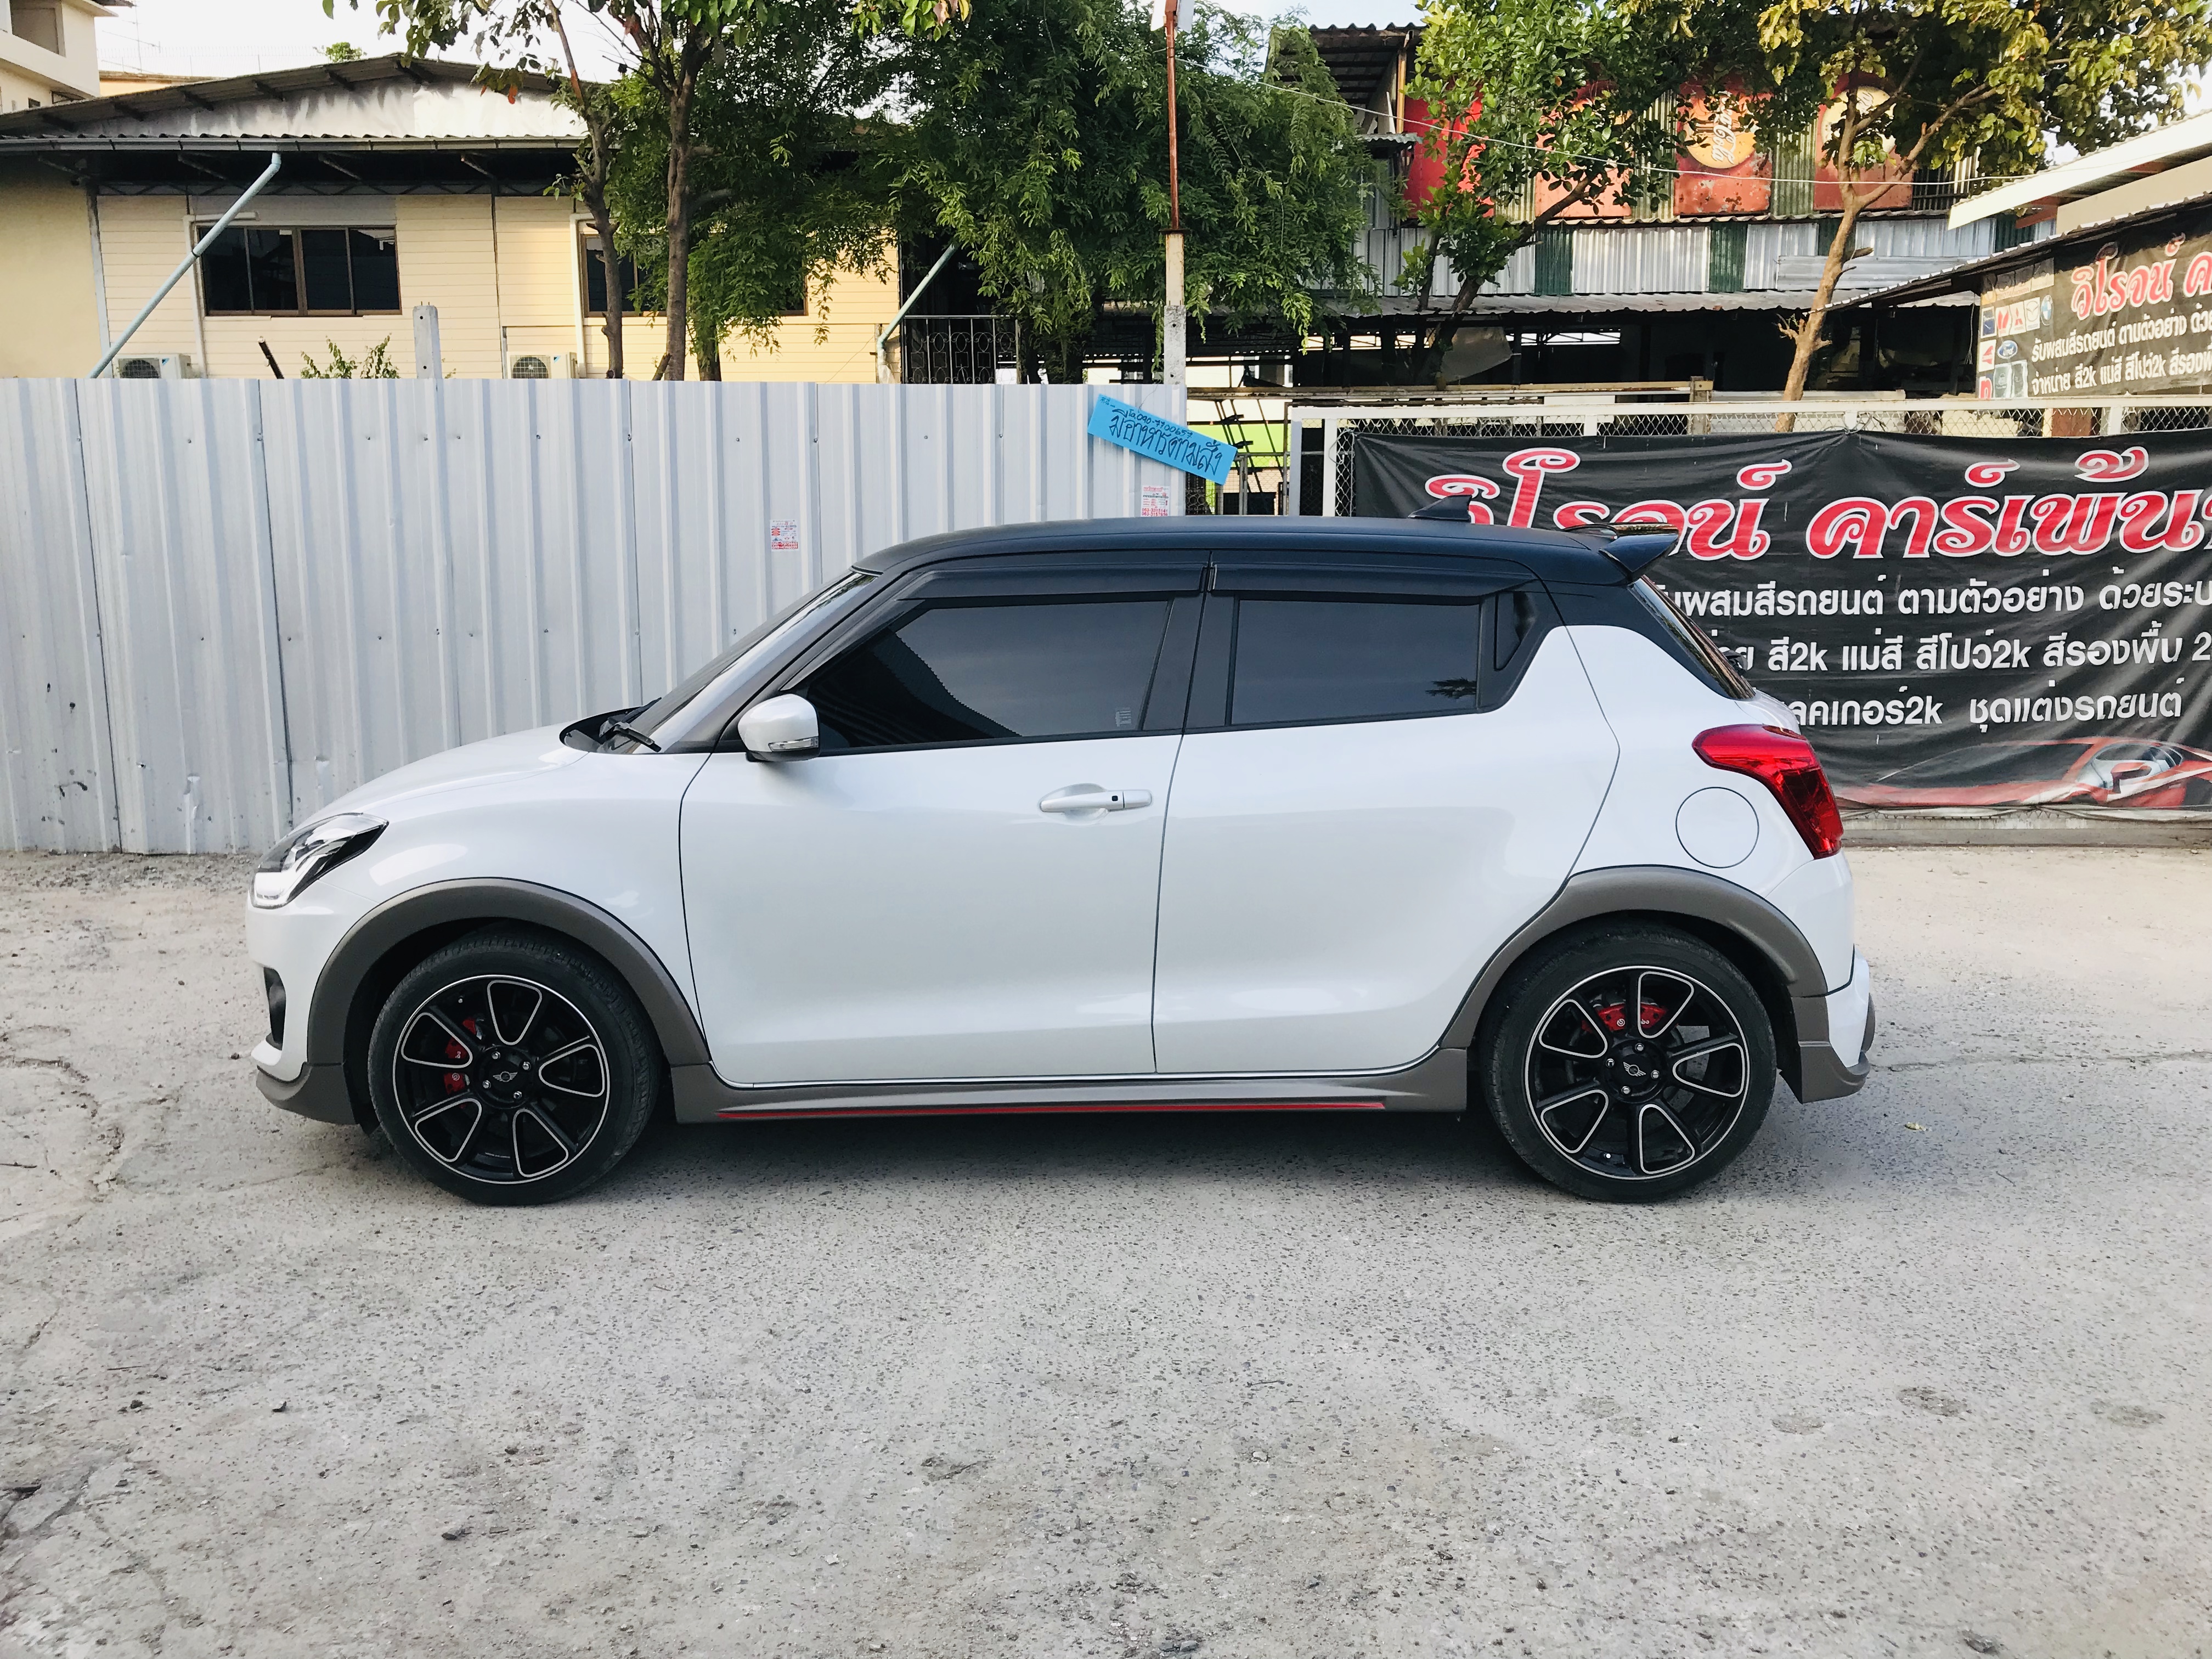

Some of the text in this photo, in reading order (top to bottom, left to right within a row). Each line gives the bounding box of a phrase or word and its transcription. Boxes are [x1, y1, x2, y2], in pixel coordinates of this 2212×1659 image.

[2119, 307, 2187, 345] ตามตัวอย่าง
[2031, 367, 2071, 396] จำหน่าย
[2074, 363, 2097, 389] สี2k
[2100, 356, 2123, 385] แม่สี
[1806, 446, 2212, 560] คาร์เพ้น
[1899, 569, 2084, 614] ตามตัวอย่าง
[1768, 636, 1828, 672] สี2k
[1842, 629, 1902, 670] แม่สี
[2044, 620, 2182, 667] สีรองพื้น
[1781, 676, 2183, 732] ลคเกอร์2k ชุดแต่งรถยนต์
